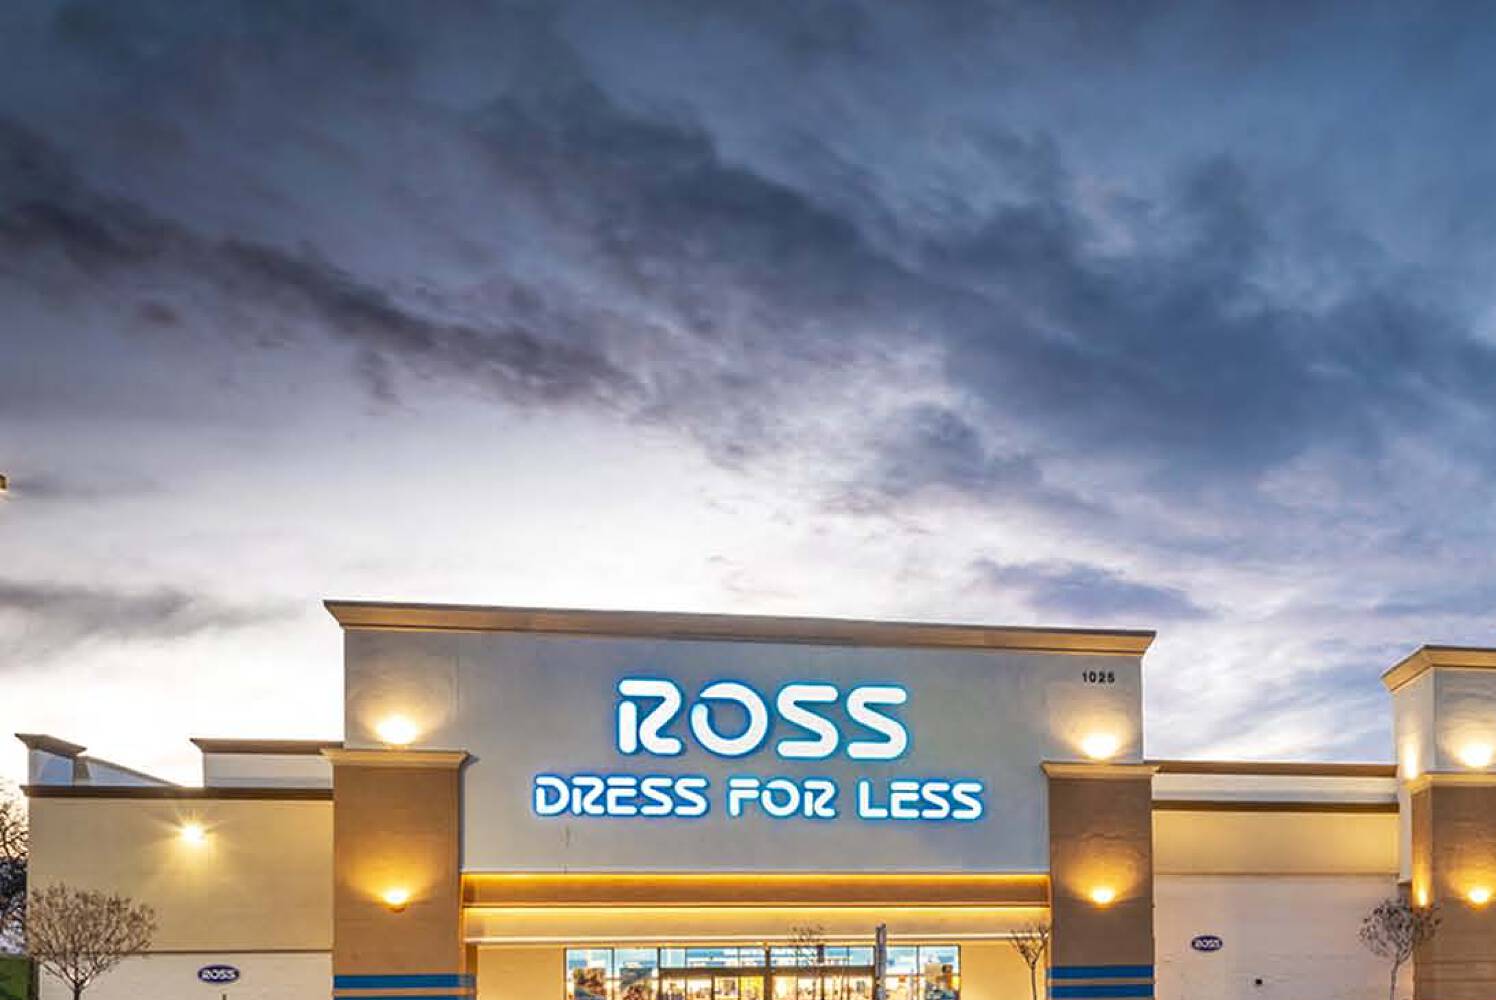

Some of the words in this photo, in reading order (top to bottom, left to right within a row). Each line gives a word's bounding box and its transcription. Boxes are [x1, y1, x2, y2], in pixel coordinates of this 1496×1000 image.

[1082, 671, 1115, 683] 1025
[617, 678, 908, 760] ROSS
[534, 775, 708, 817] DRESS
[729, 777, 838, 818] FOR
[859, 780, 984, 820] LESS
[201, 969, 236, 980] ROSS
